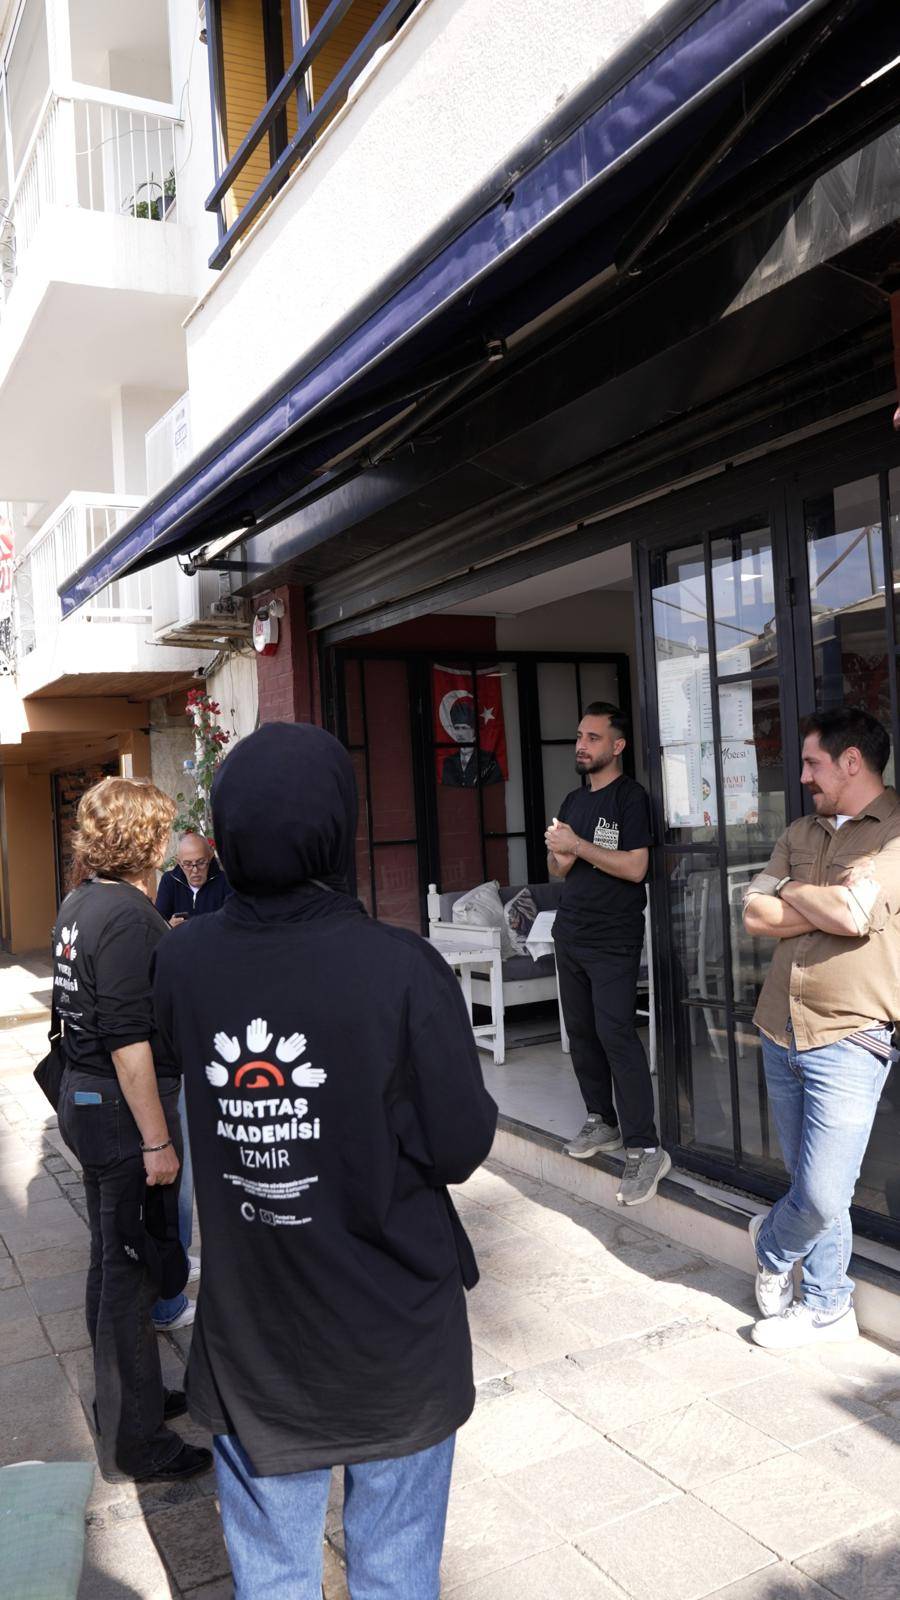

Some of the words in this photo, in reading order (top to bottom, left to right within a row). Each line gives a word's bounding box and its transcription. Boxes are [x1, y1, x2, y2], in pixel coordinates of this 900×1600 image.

[597, 816, 610, 829] Do
[612, 821, 618, 830] it
[218, 1098, 309, 1118] YURTTAŞ
[217, 1117, 320, 1143] AKADEMİSİ
[240, 1147, 290, 1168] İZMİR
